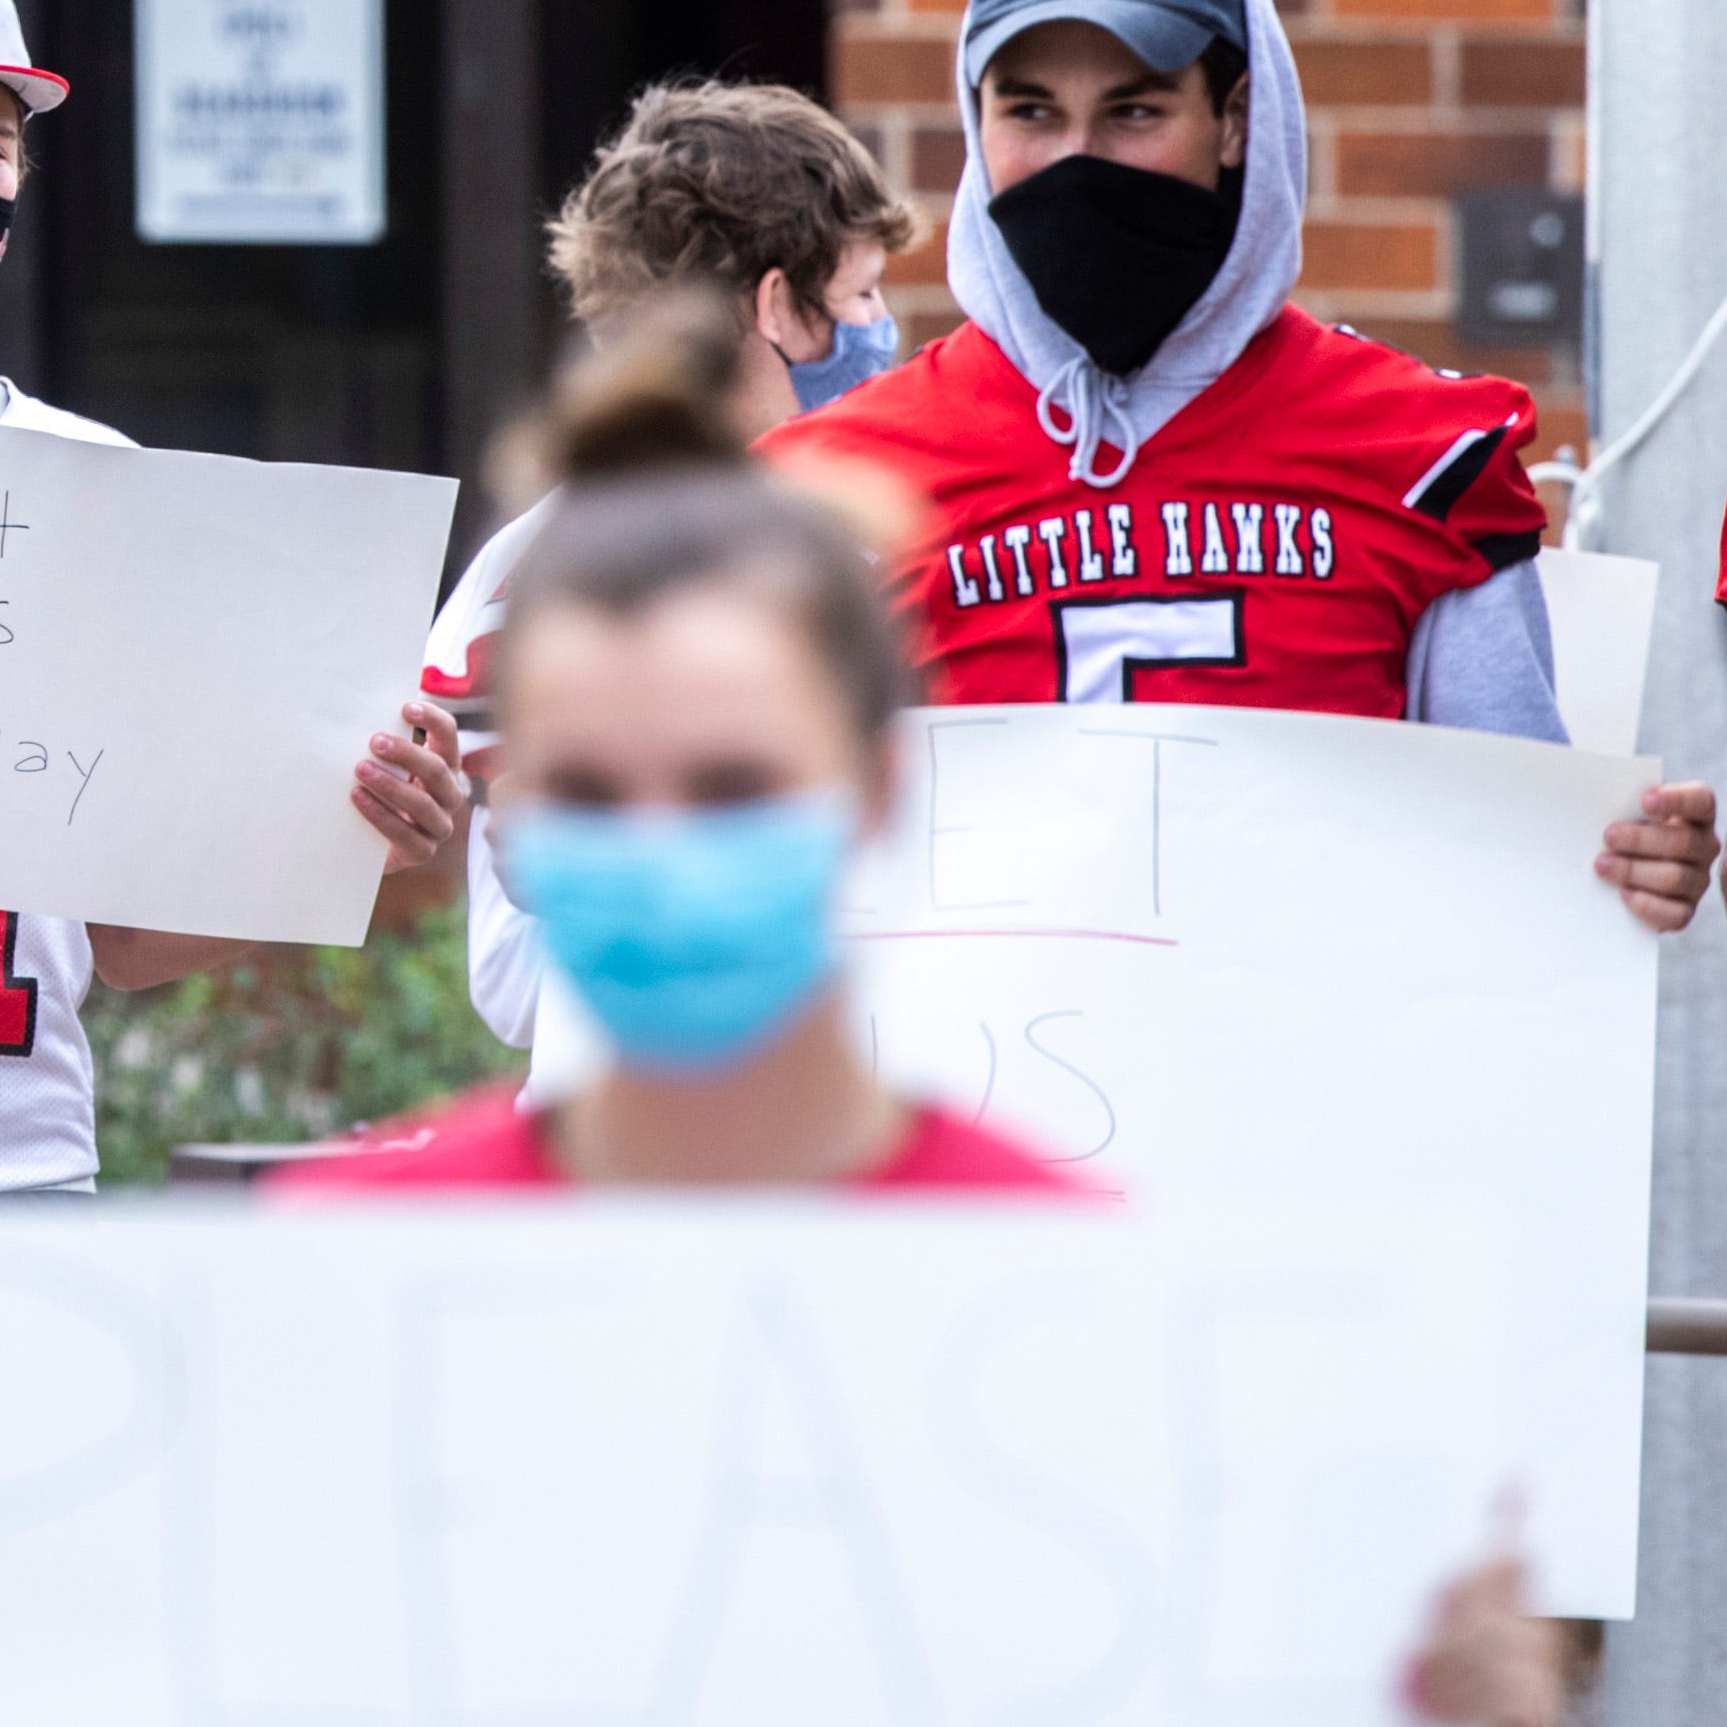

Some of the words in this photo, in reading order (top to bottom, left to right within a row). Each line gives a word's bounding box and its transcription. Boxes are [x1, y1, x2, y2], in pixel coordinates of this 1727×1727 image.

[945, 501, 1137, 609] LITTLE
[1159, 500, 1336, 579] HAWKS
[929, 716, 1219, 917] ET
